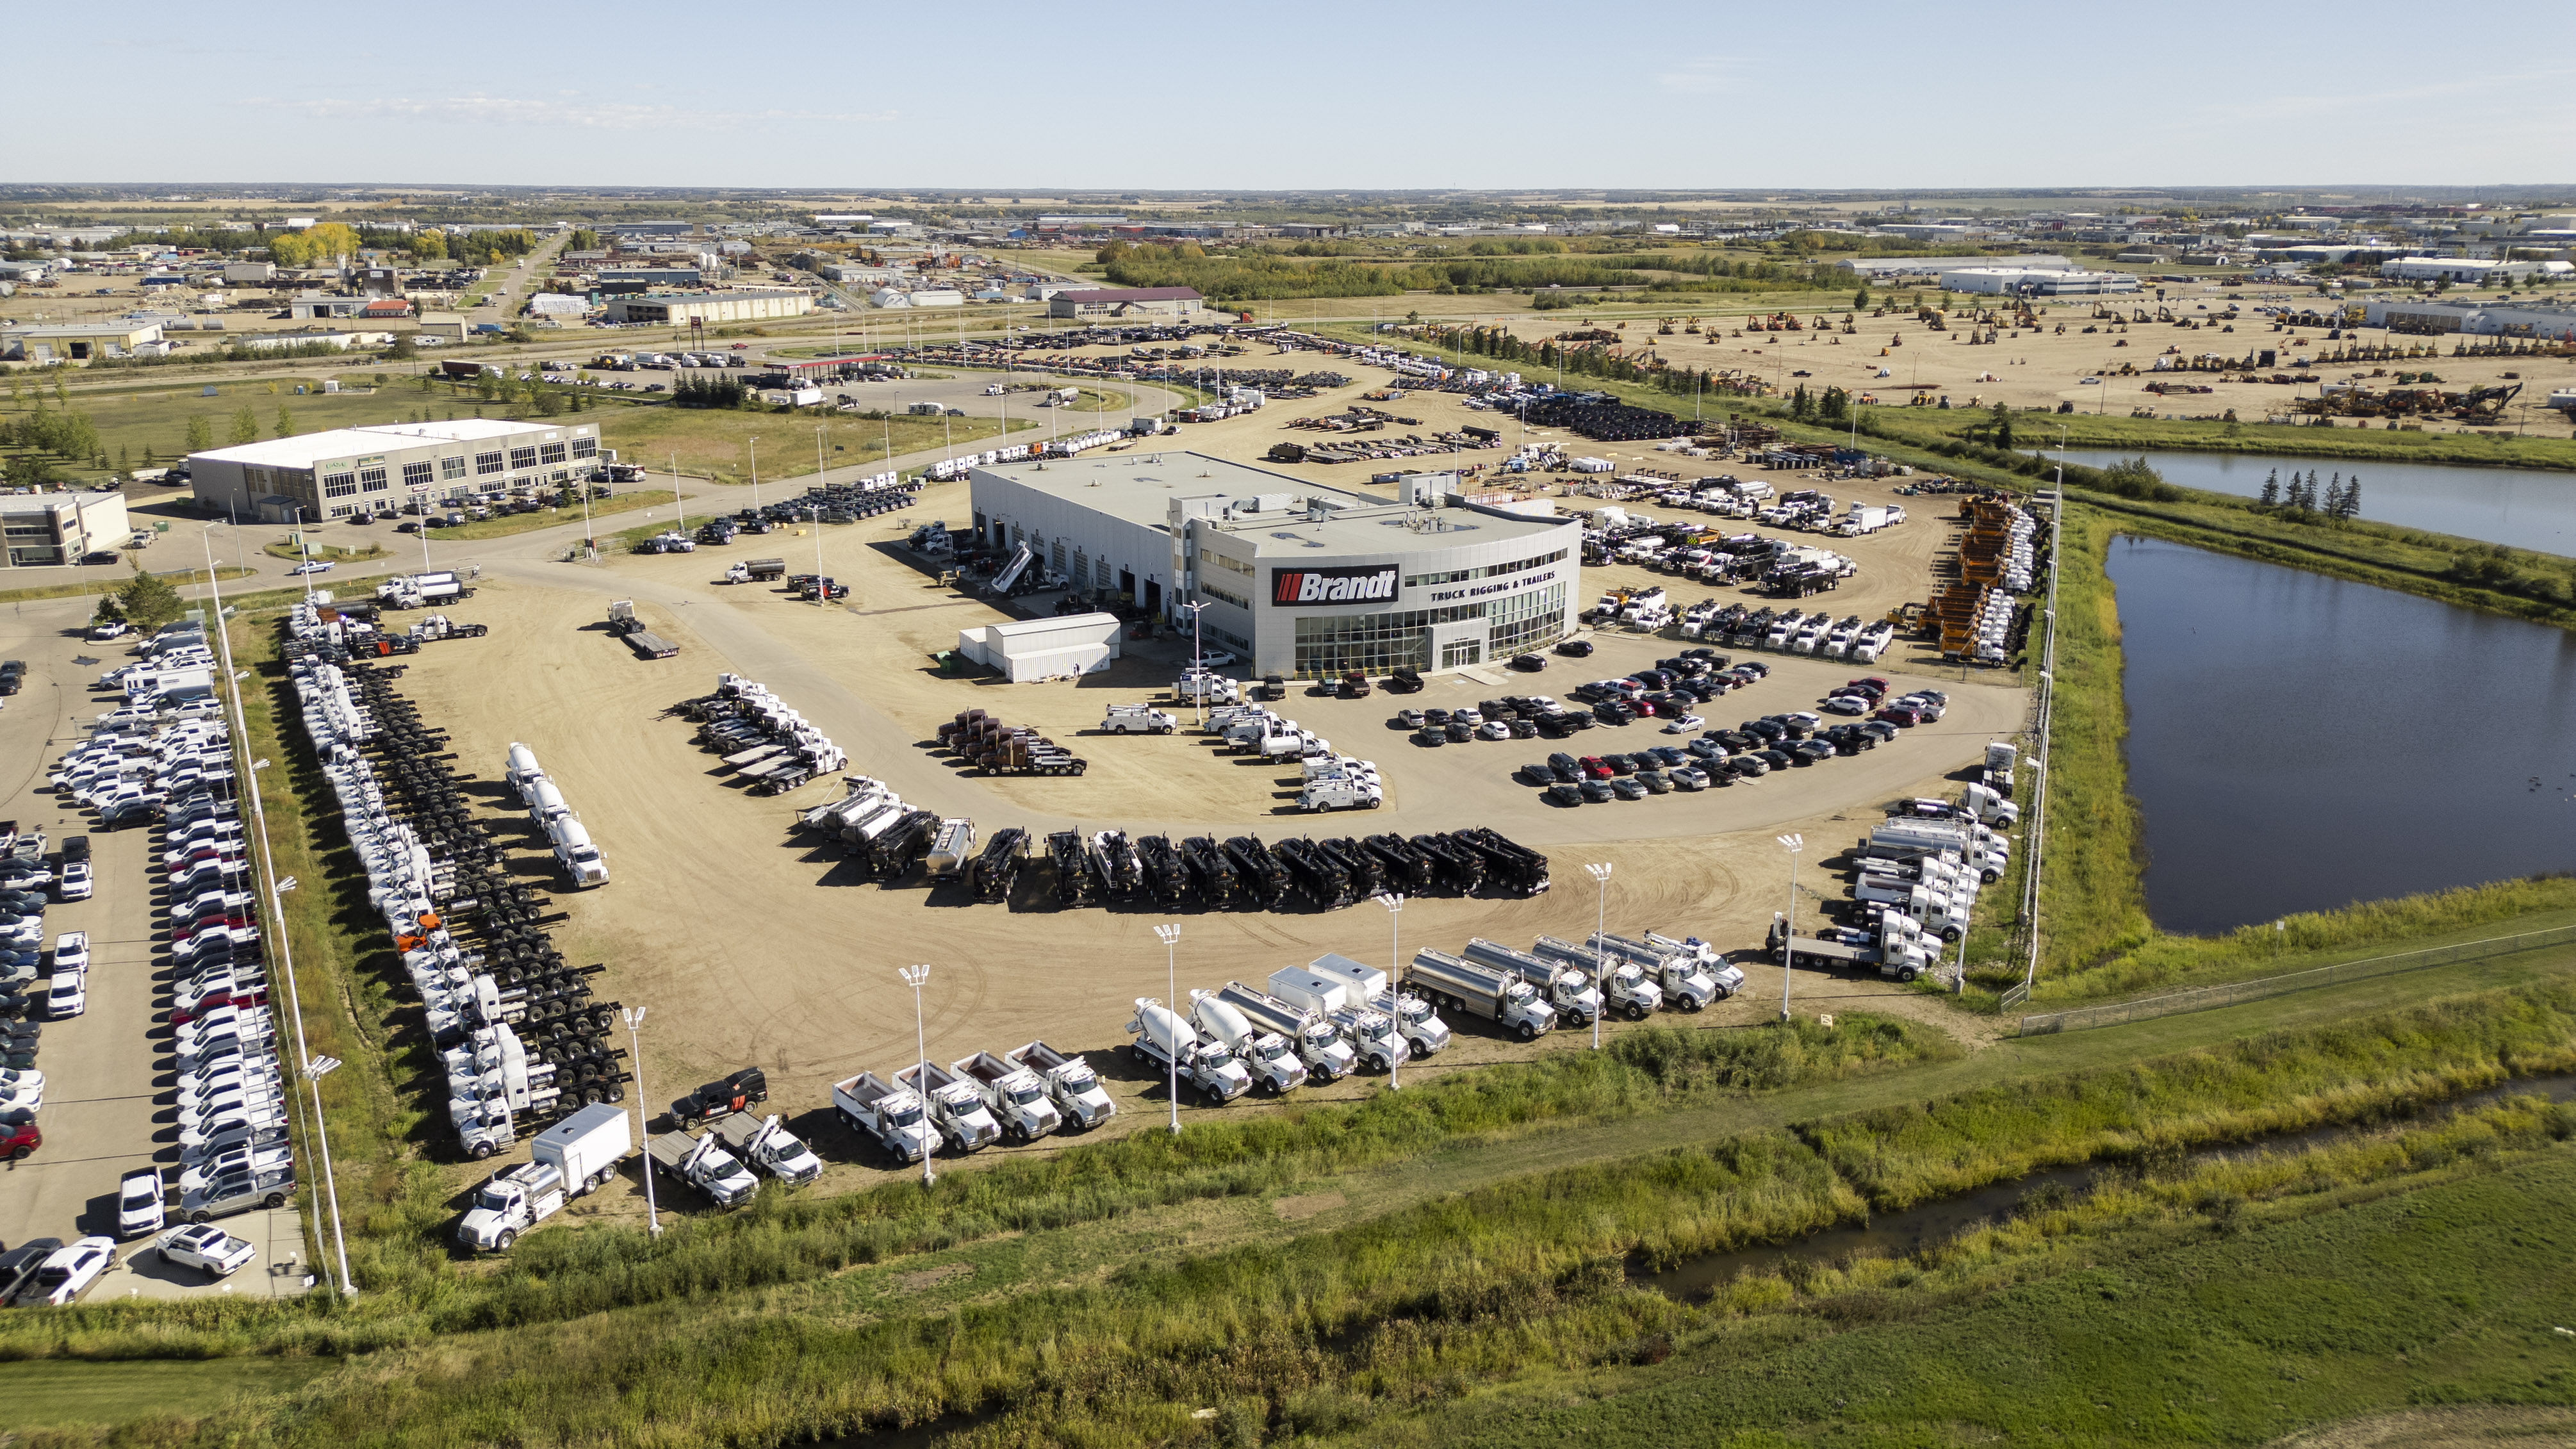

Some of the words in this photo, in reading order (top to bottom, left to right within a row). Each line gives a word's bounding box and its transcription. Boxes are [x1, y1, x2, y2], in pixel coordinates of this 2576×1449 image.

[1298, 571, 1396, 601] Brandt
[1431, 589, 1465, 602] TRUCK
[1470, 582, 1509, 596] RIGGING
[1513, 580, 1519, 589] &
[1522, 571, 1555, 587] TRAILERS
